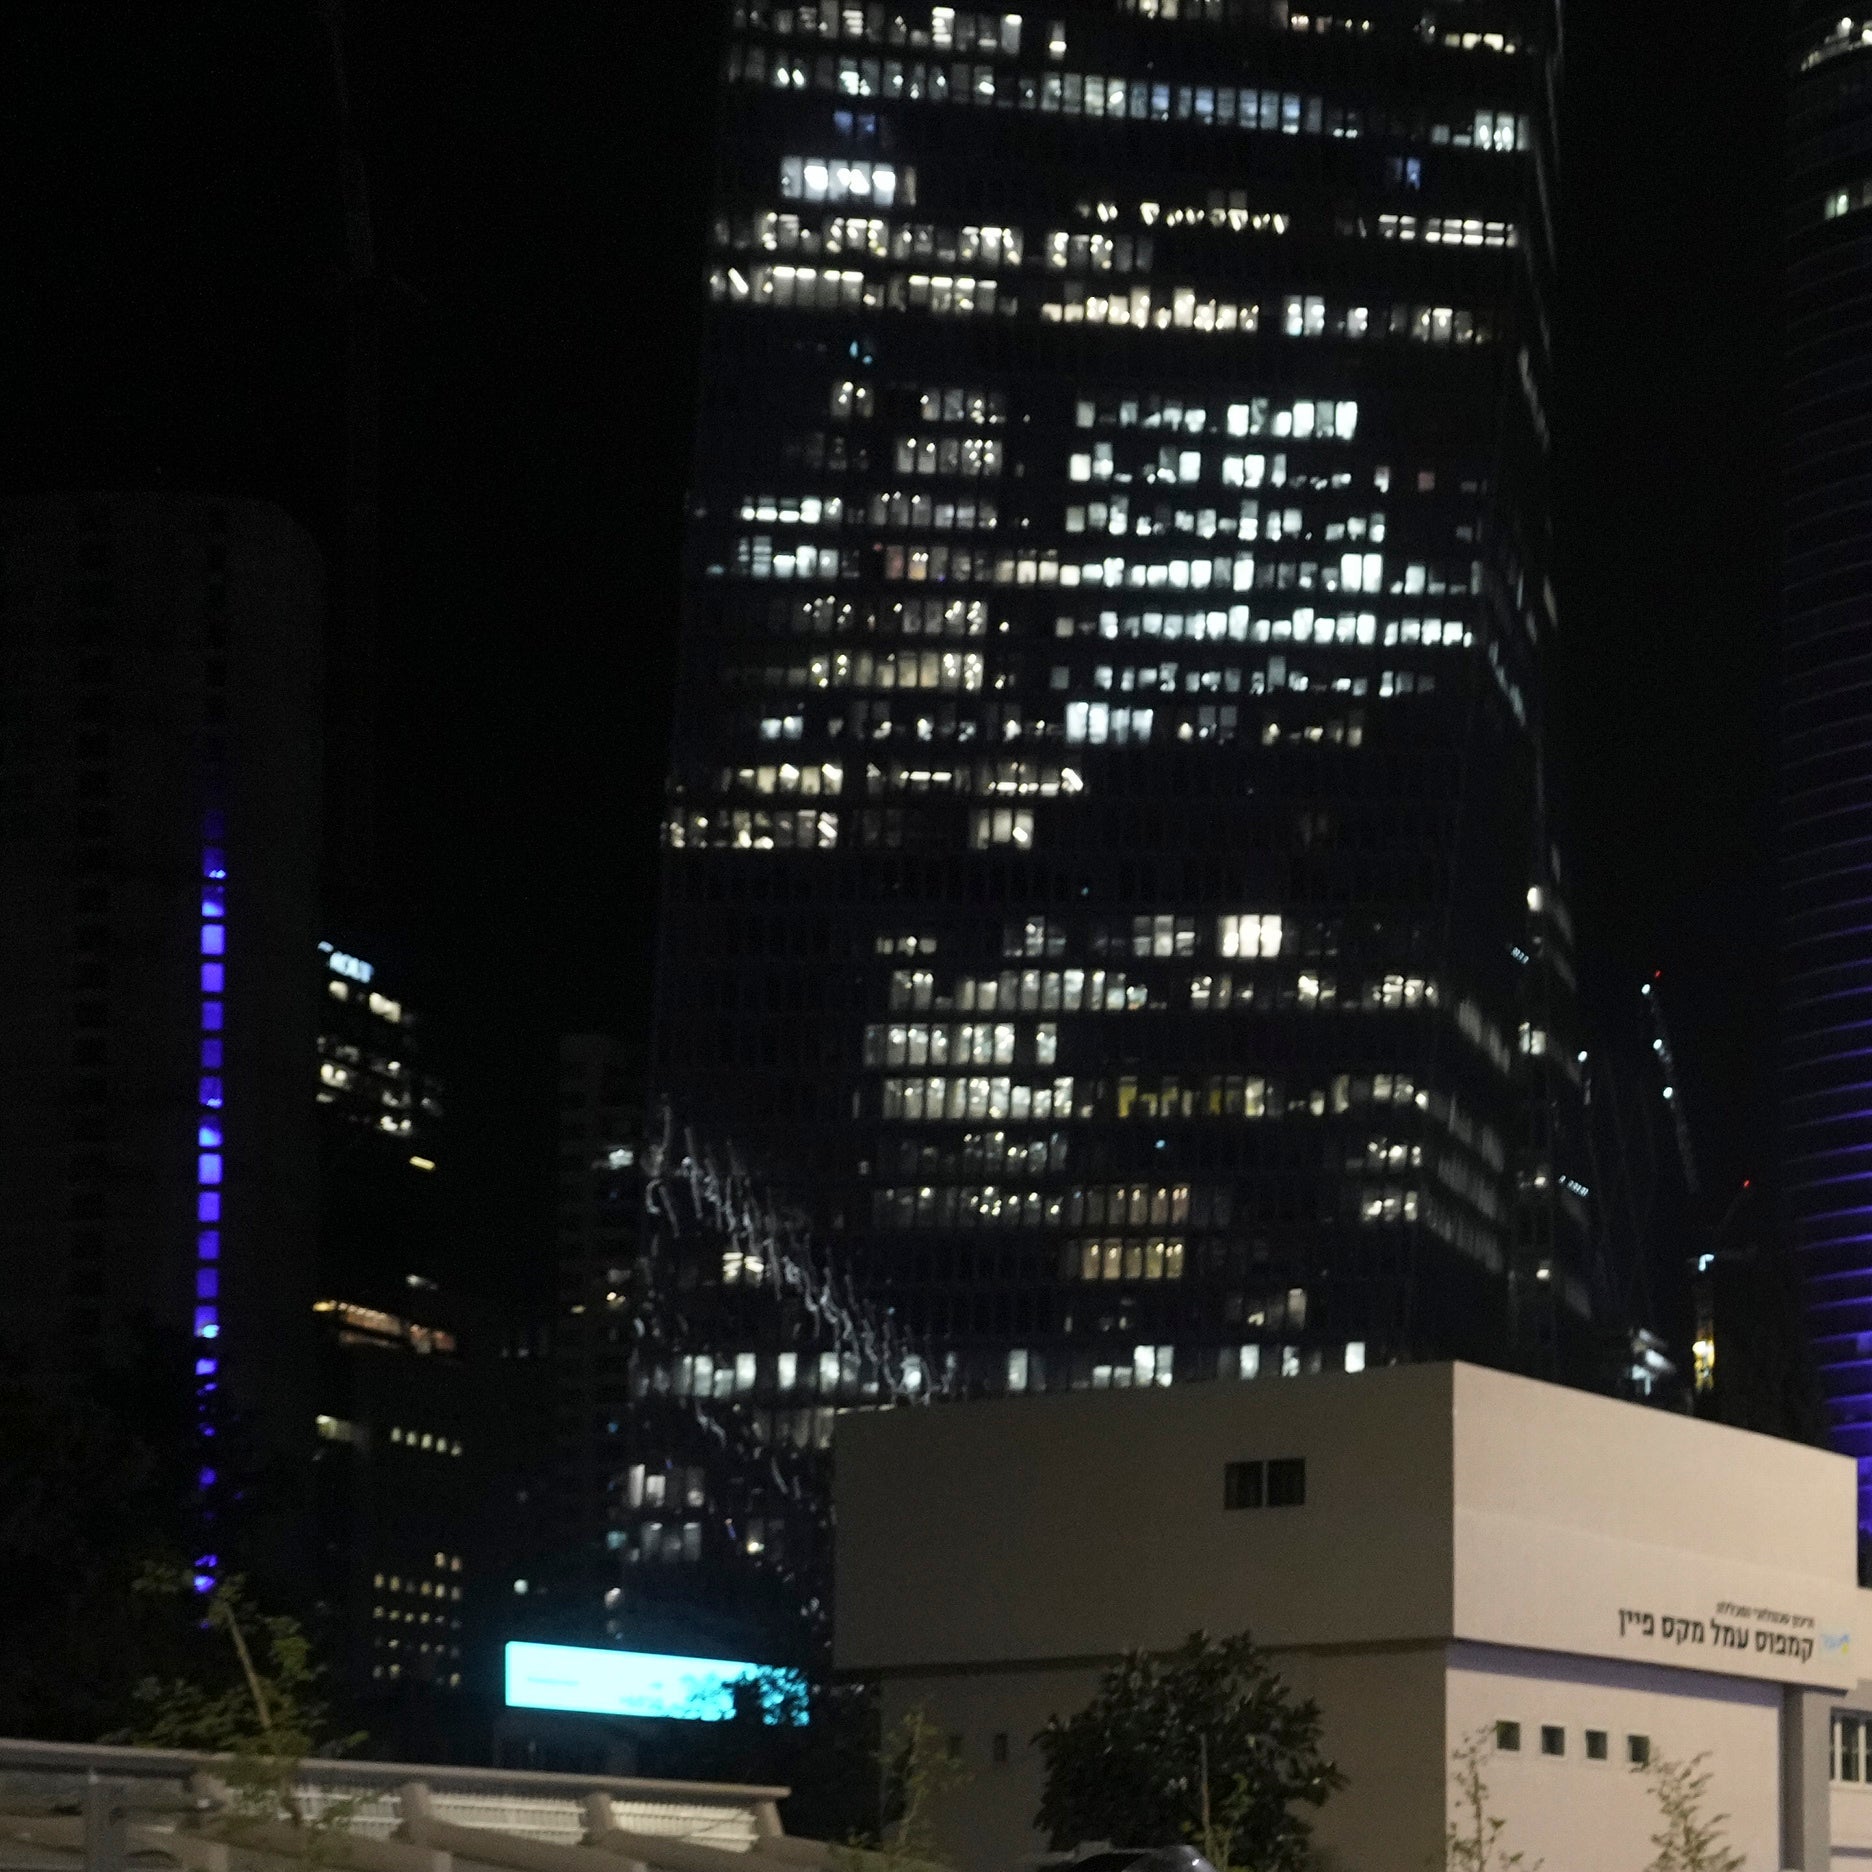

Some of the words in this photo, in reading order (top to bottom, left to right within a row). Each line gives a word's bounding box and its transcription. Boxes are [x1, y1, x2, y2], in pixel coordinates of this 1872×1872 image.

[1618, 1608, 1655, 1637] פיין
[1661, 1615, 1705, 1645] מקס
[1709, 1617, 1749, 1649] עמל
[1755, 1630, 1815, 1664] קמפוס
